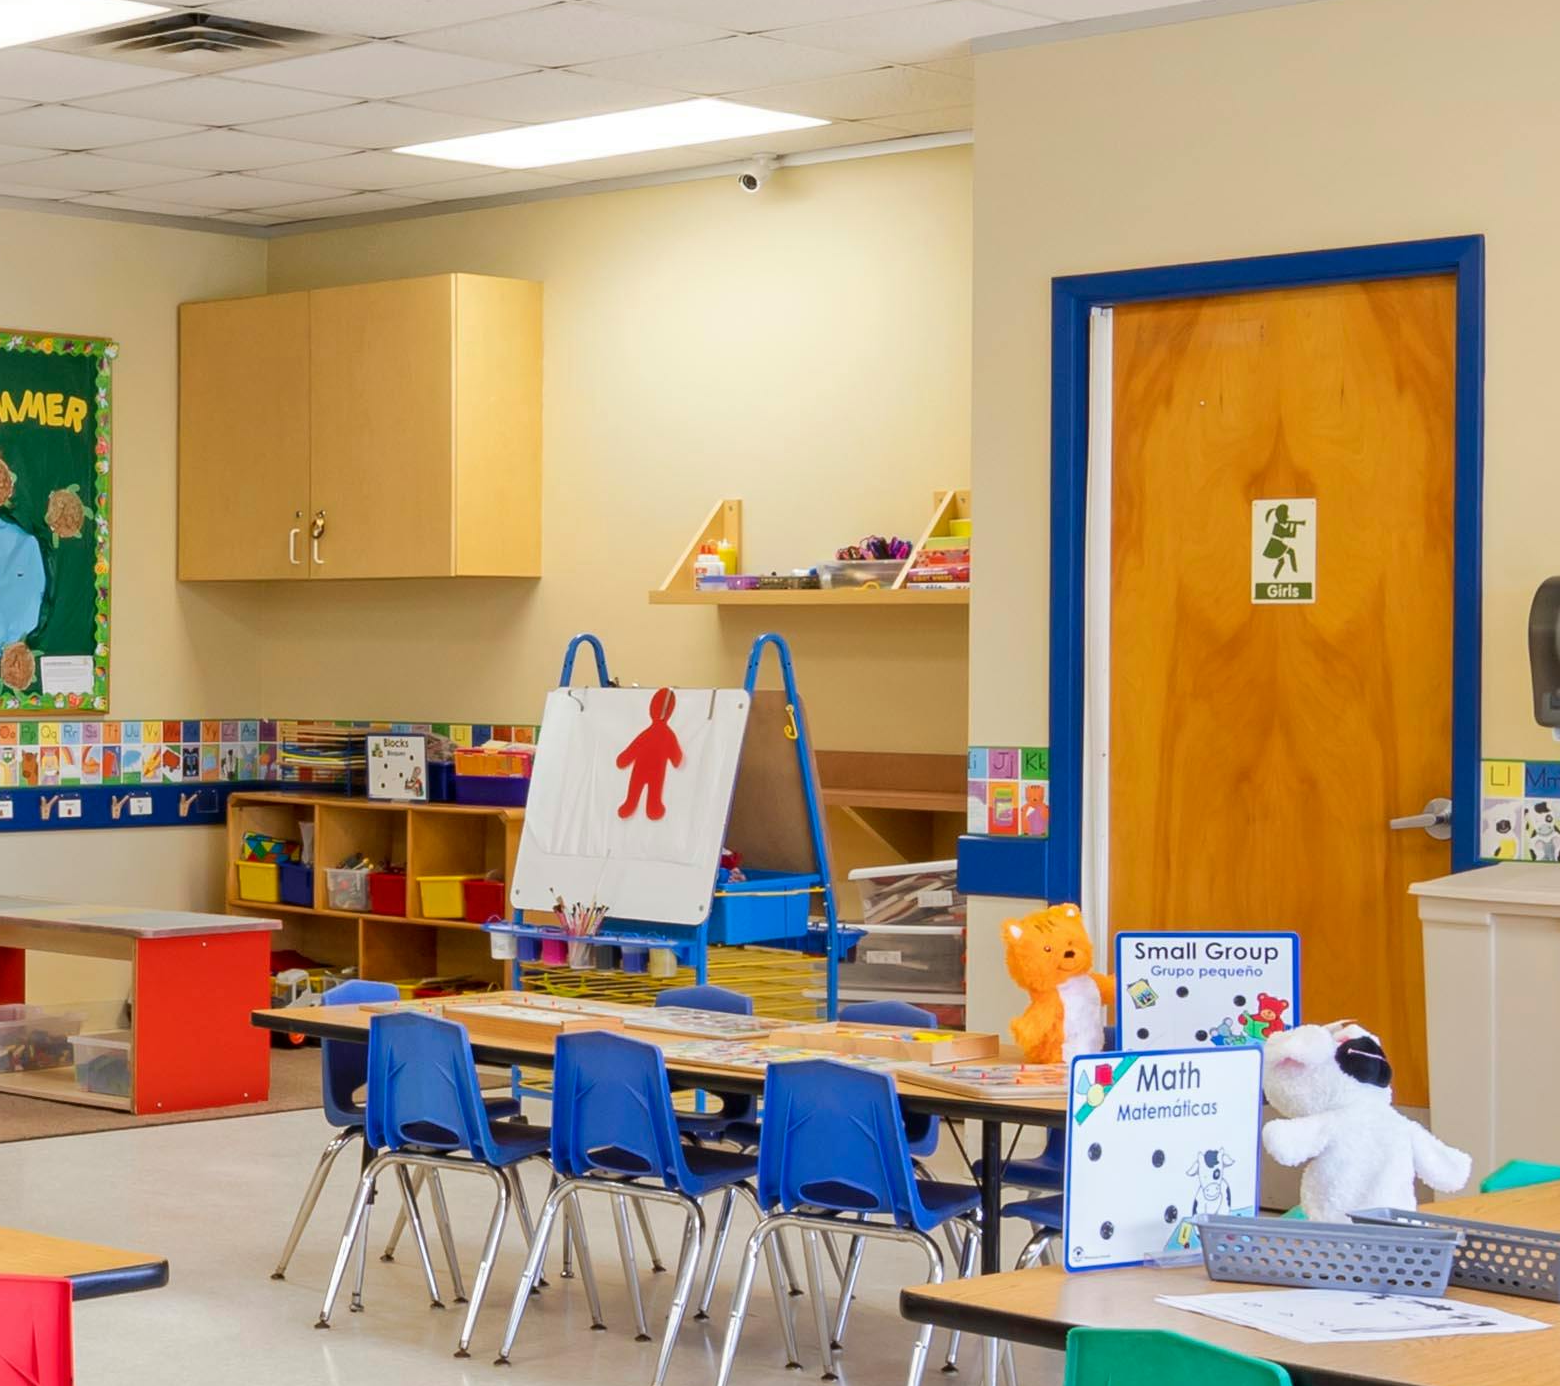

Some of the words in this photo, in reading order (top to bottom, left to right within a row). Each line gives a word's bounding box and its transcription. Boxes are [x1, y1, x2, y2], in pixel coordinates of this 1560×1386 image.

[1266, 584, 1300, 599] Girls
[383, 737, 409, 749] Blocks
[993, 751, 1014, 779] Jj
[1025, 752, 1047, 772] Kk
[1490, 765, 1511, 787] Ll
[1134, 940, 1199, 961] Small
[1205, 941, 1280, 964] Group
[1150, 964, 1194, 979] Grupo
[1198, 963, 1264, 979] pequeño
[1137, 1060, 1201, 1093] Math
[1116, 1098, 1218, 1123] Matemáticas
